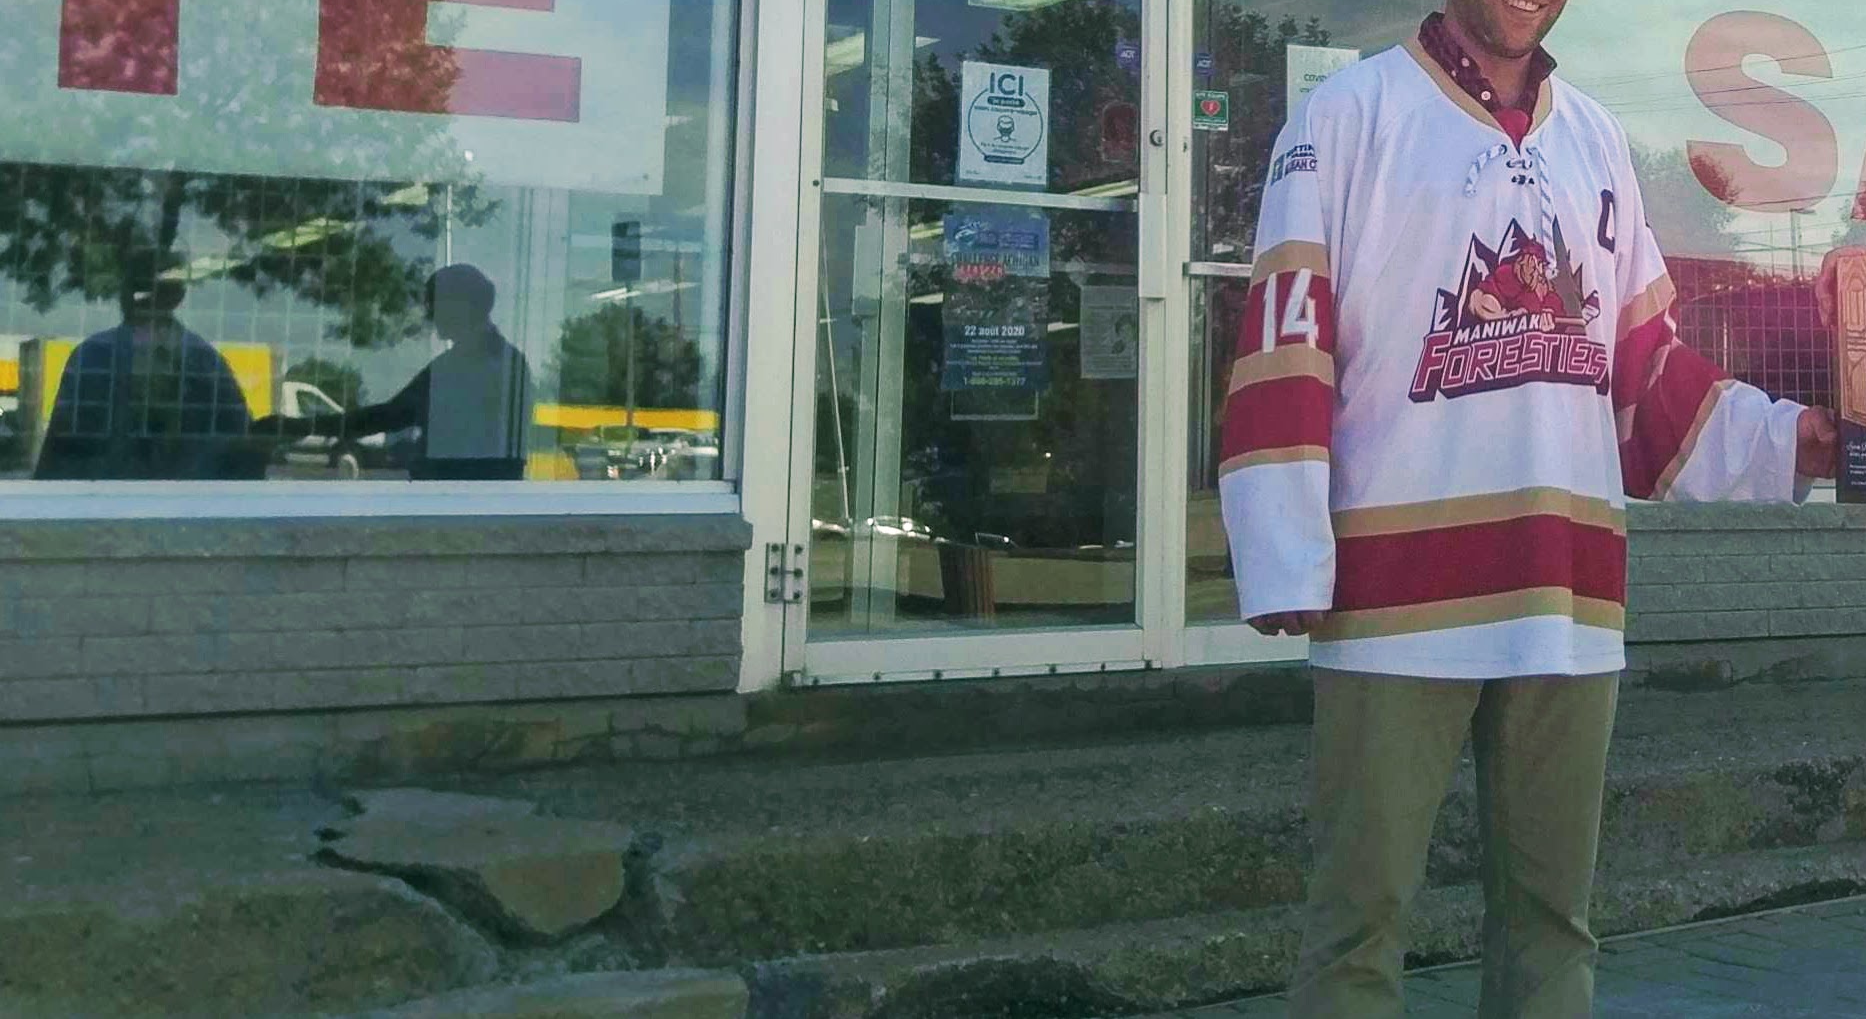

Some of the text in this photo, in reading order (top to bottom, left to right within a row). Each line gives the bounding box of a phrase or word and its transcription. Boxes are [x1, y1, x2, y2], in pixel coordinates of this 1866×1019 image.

[989, 72, 1024, 97] ICI
[1262, 267, 1320, 354] 14
[964, 324, 977, 336] 22
[1001, 325, 1026, 337] 2020
[1453, 312, 1555, 346] MANIWAK
[1408, 330, 1609, 403] FORESTIER
